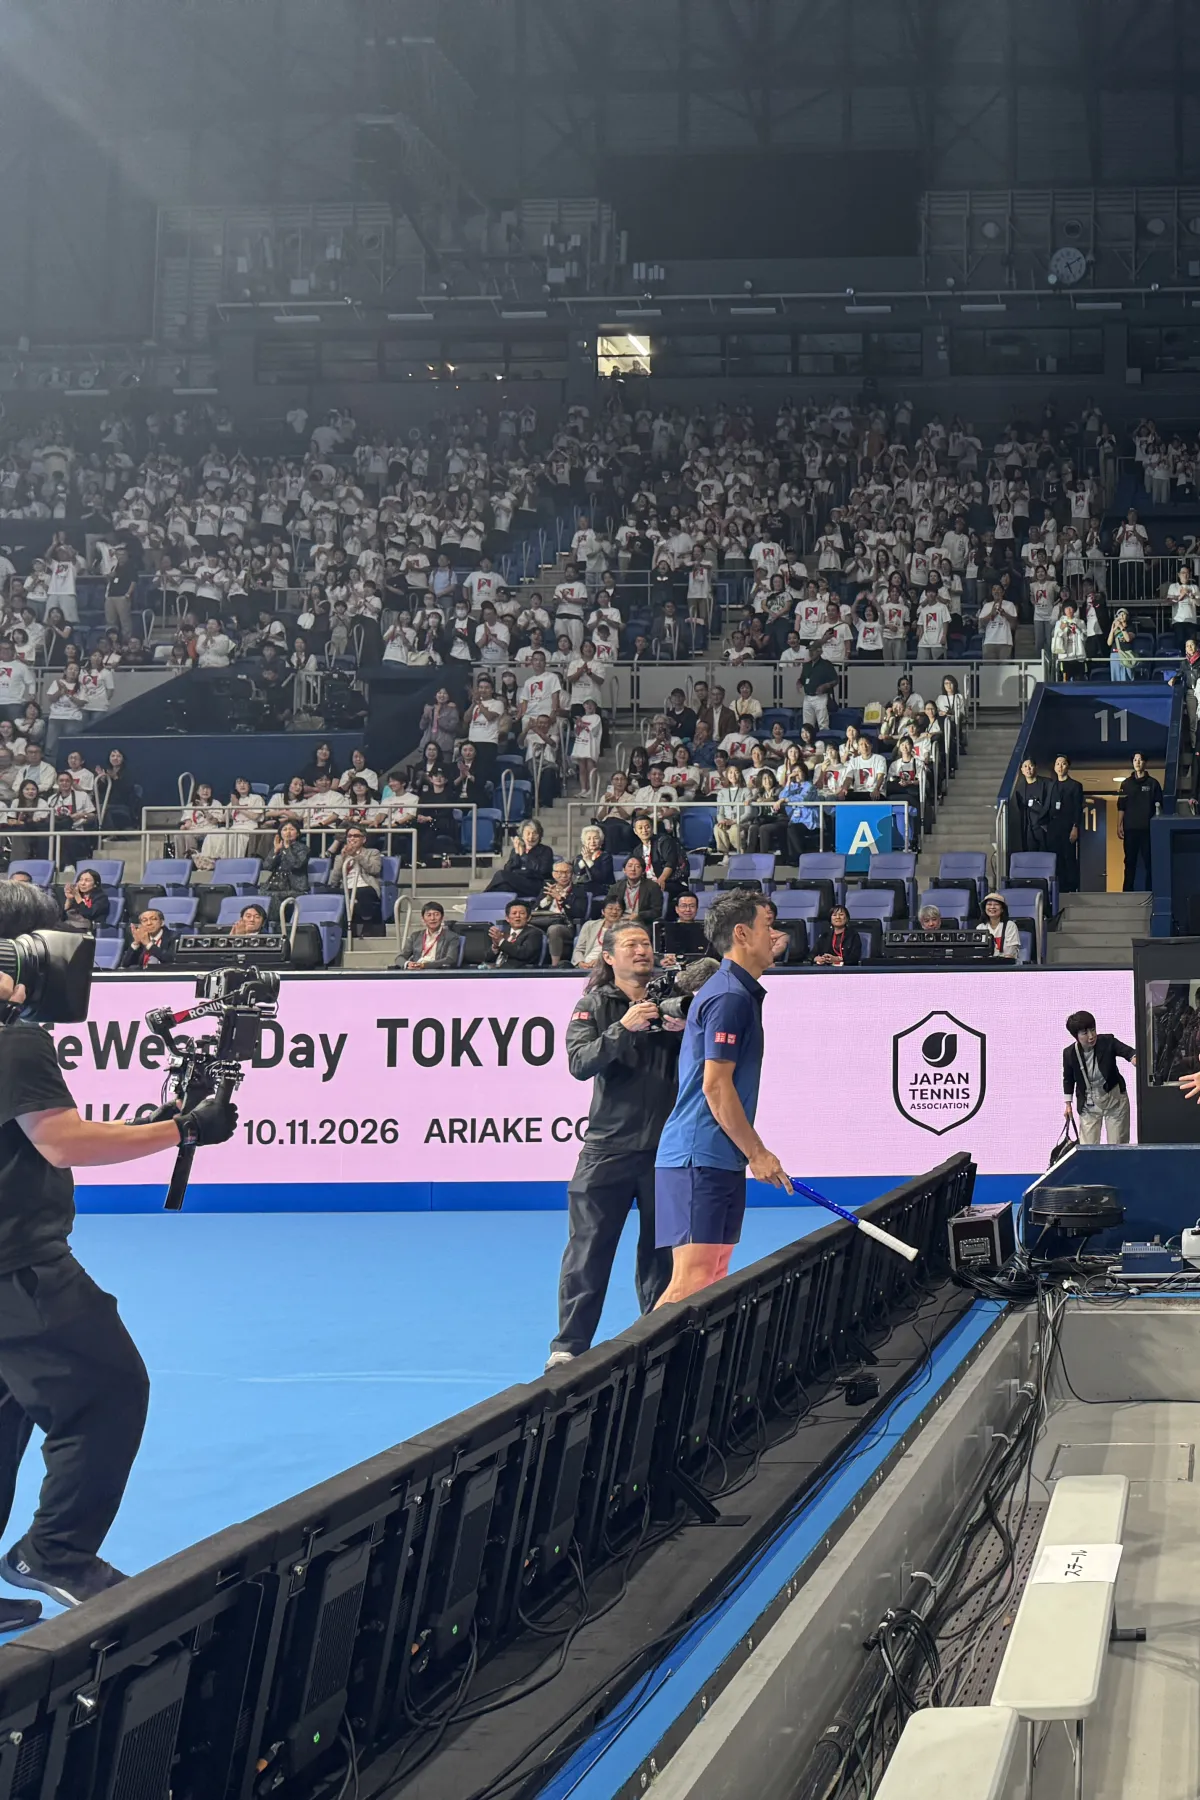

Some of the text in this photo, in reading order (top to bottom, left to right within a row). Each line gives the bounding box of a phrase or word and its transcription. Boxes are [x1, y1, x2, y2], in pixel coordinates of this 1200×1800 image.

[1094, 709, 1128, 742] 11
[1083, 806, 1097, 832] 11
[848, 821, 879, 855] A
[189, 999, 225, 1019] RONIN
[252, 1019, 348, 1083] Day
[377, 1017, 555, 1068] TOKYO
[910, 1072, 969, 1085] JAPAN
[909, 1088, 970, 1100] TENNIS
[910, 1102, 969, 1110] ASSOCIATION
[243, 1119, 399, 1144] 10.11.2026
[424, 1117, 543, 1143] ARIAKE
[1064, 1549, 1088, 1577] スチール
